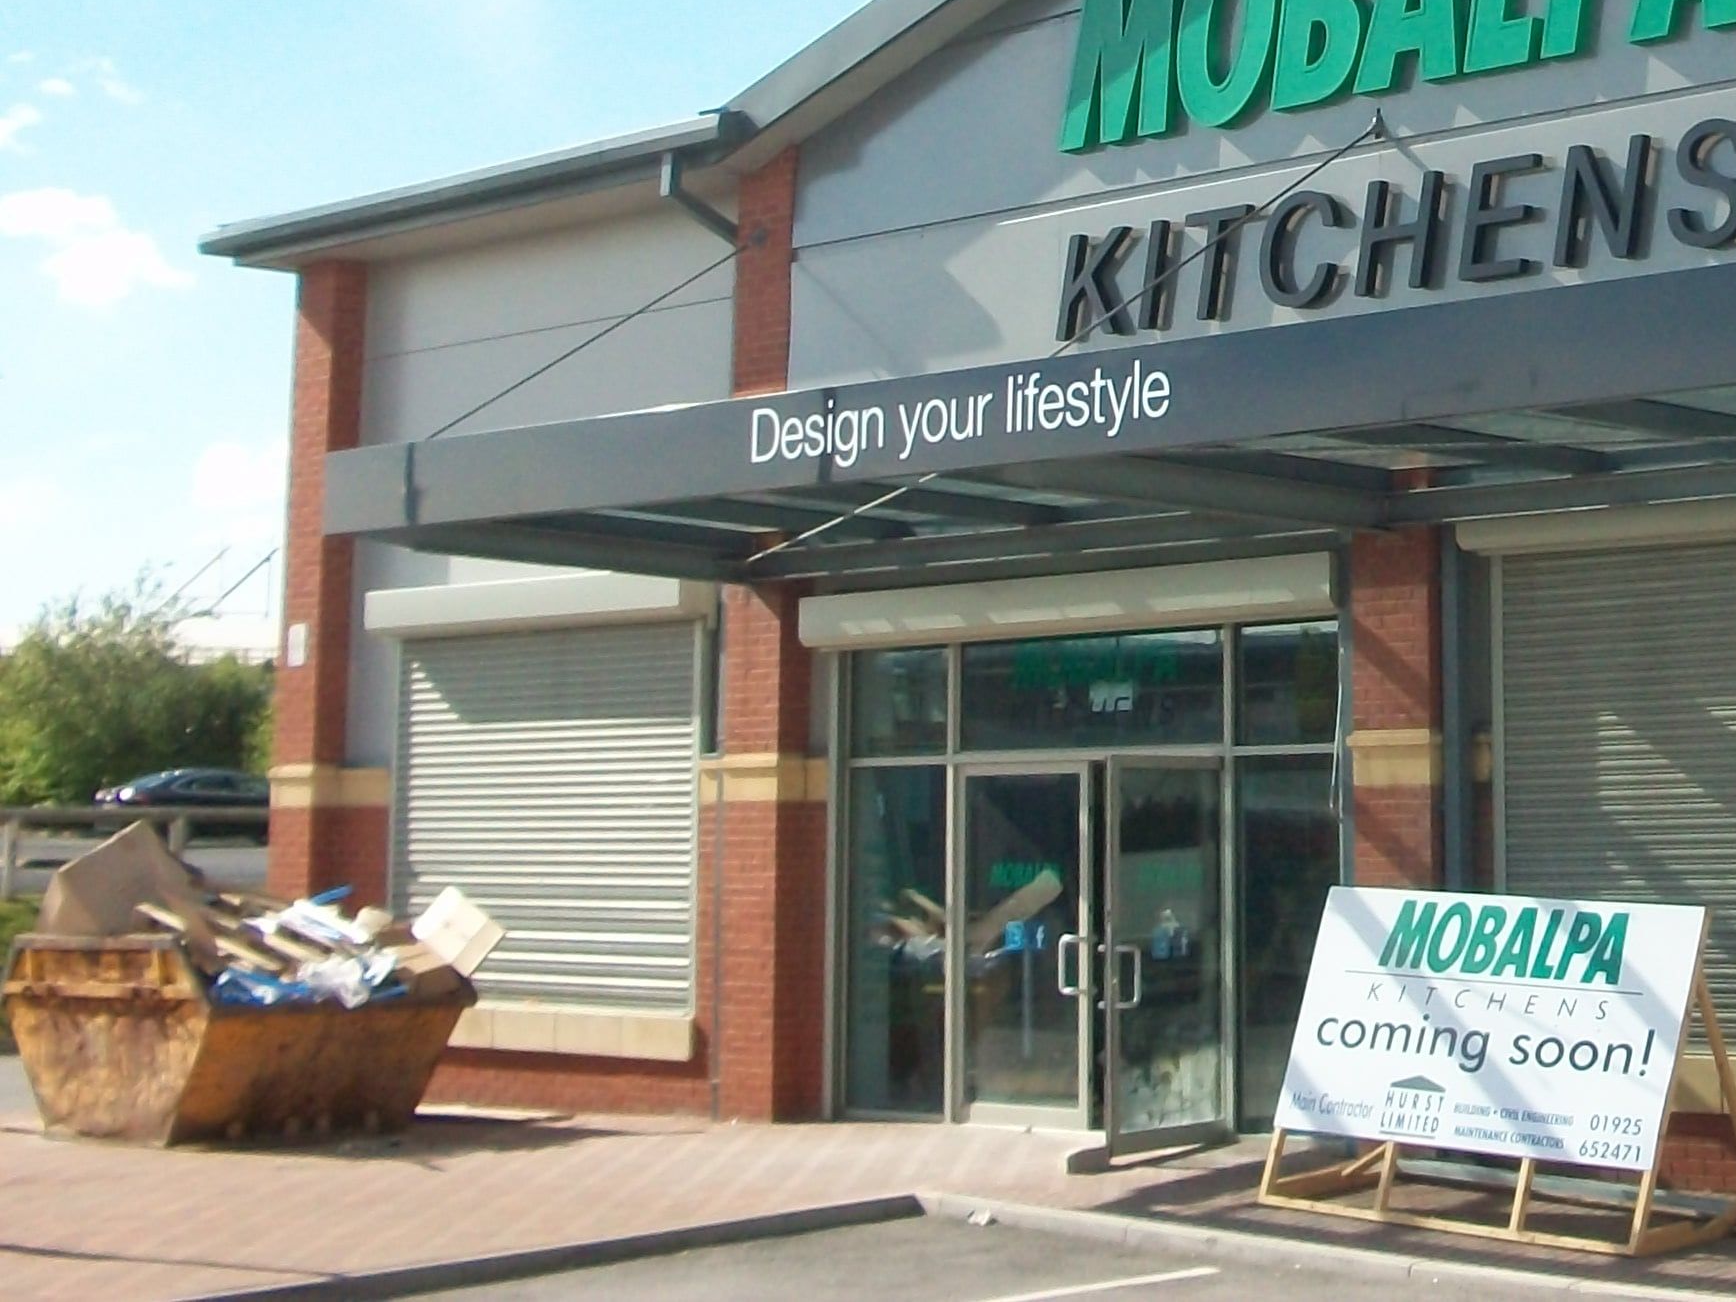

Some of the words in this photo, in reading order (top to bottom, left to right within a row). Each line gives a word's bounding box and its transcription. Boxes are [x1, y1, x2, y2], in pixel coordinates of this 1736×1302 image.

[749, 399, 885, 468] Design
[898, 391, 993, 460] your
[1004, 359, 1171, 438] lifestyle
[1378, 900, 1631, 986] MOBALPA
[1366, 983, 1610, 1021] KITCHENS
[1316, 1014, 1490, 1074] coming
[1508, 1028, 1656, 1077] soon!
[1291, 1091, 1316, 1111] Main
[1318, 1092, 1374, 1120] Contractor
[1384, 1089, 1445, 1114] HURST
[1380, 1111, 1440, 1135] LIMITED
[1453, 1102, 1491, 1117] BUILDING
[1521, 1109, 1575, 1127] ENGINEERING
[1590, 1114, 1644, 1136] 01925
[1453, 1125, 1508, 1142] MAINTENANCE
[1510, 1131, 1565, 1149] CONTRACTORS
[1579, 1138, 1642, 1163] 652471
